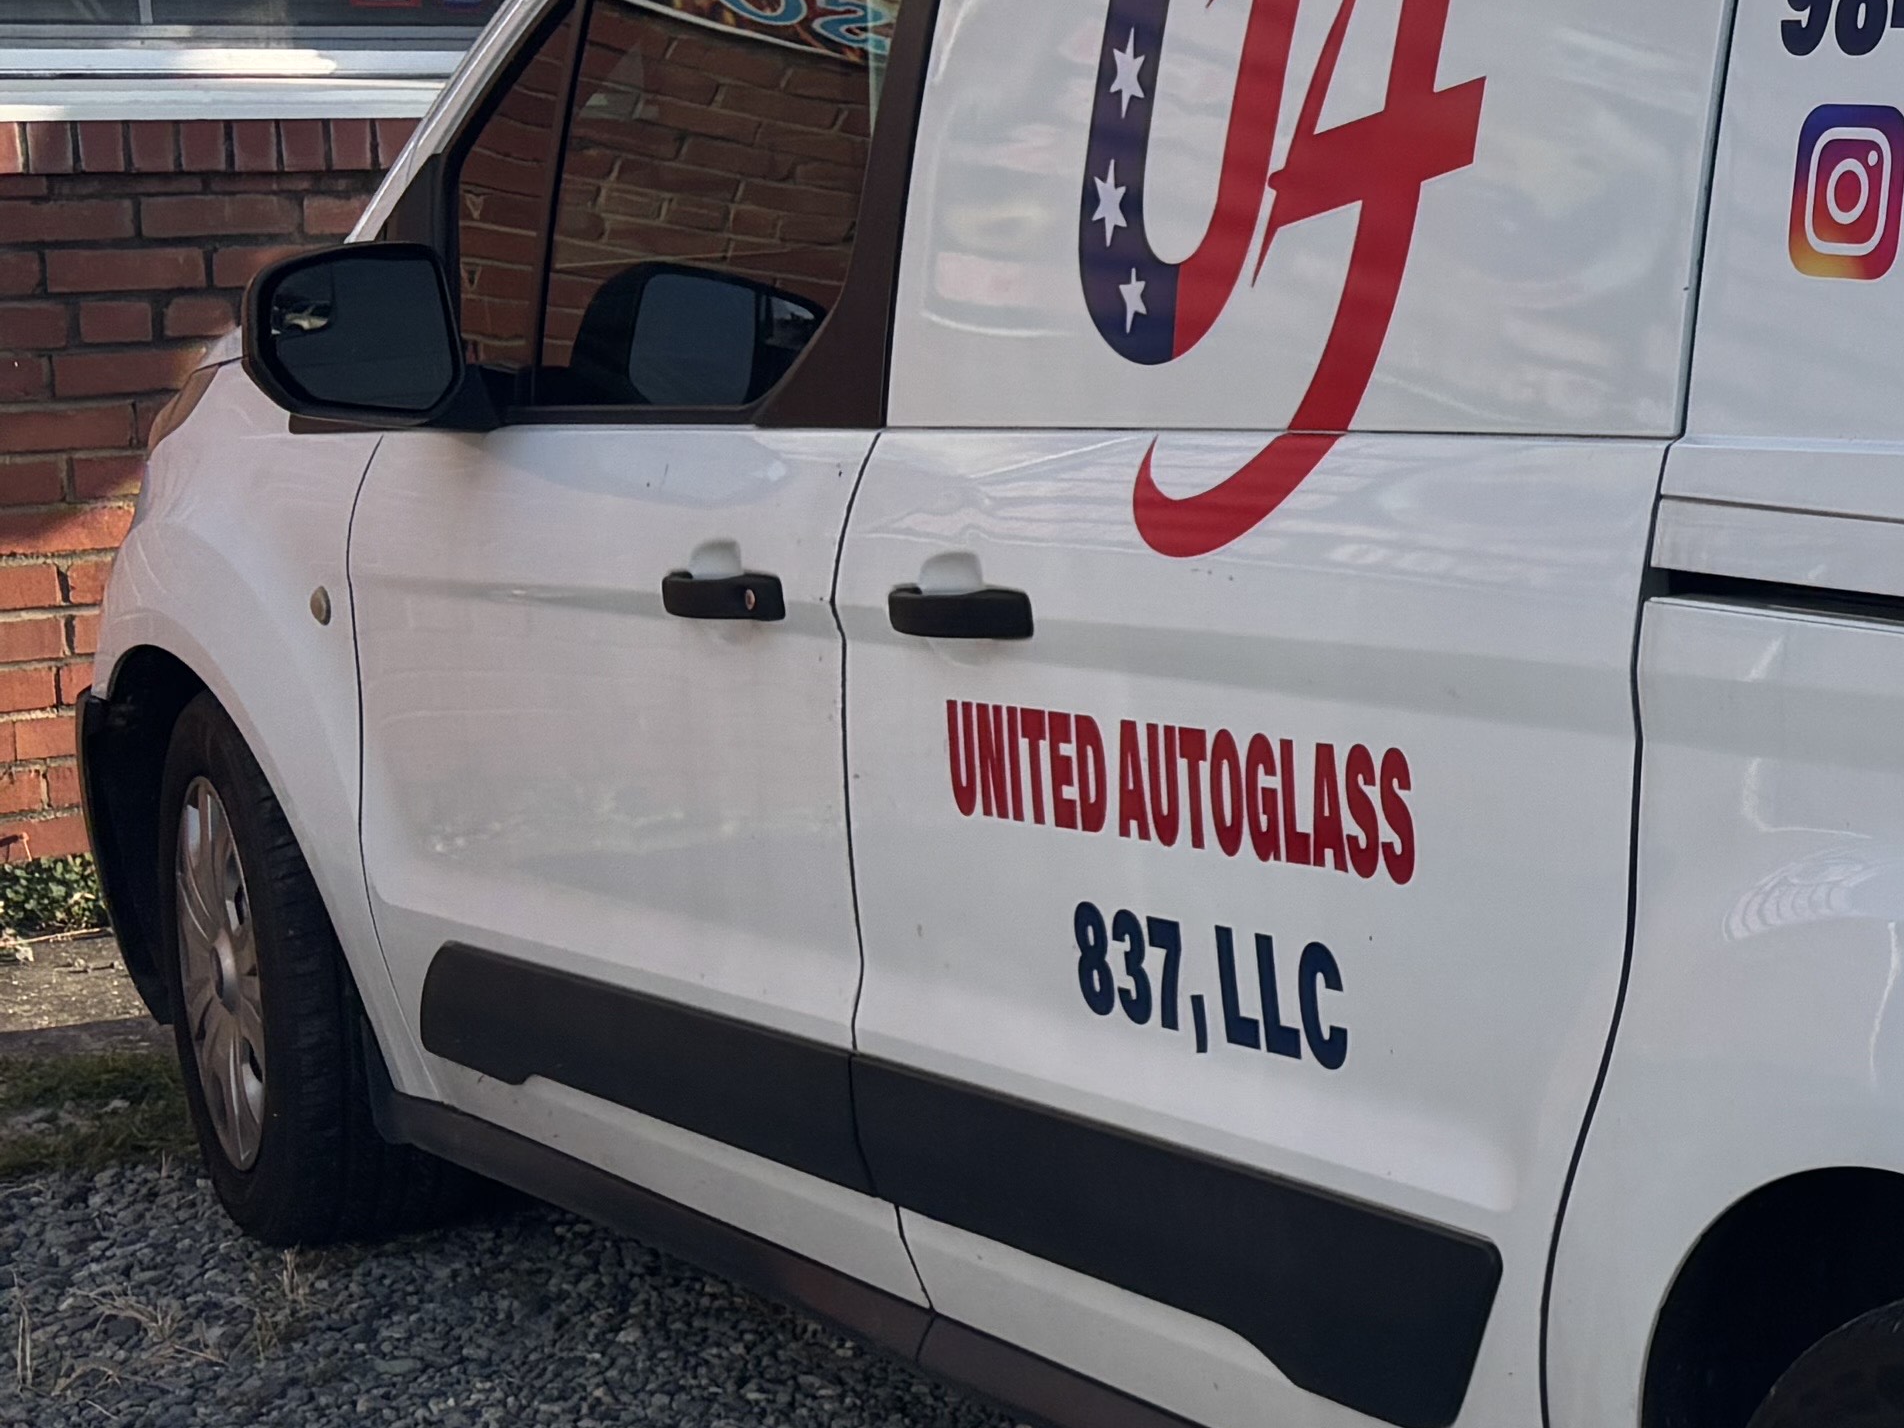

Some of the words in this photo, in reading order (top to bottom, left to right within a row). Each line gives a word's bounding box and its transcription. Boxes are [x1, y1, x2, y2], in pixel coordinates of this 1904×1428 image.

[946, 699, 1107, 833] UNITED
[1119, 719, 1415, 885] AUTOGLASS
[1074, 901, 1208, 1054] 837,
[1214, 925, 1348, 1070] LLC
